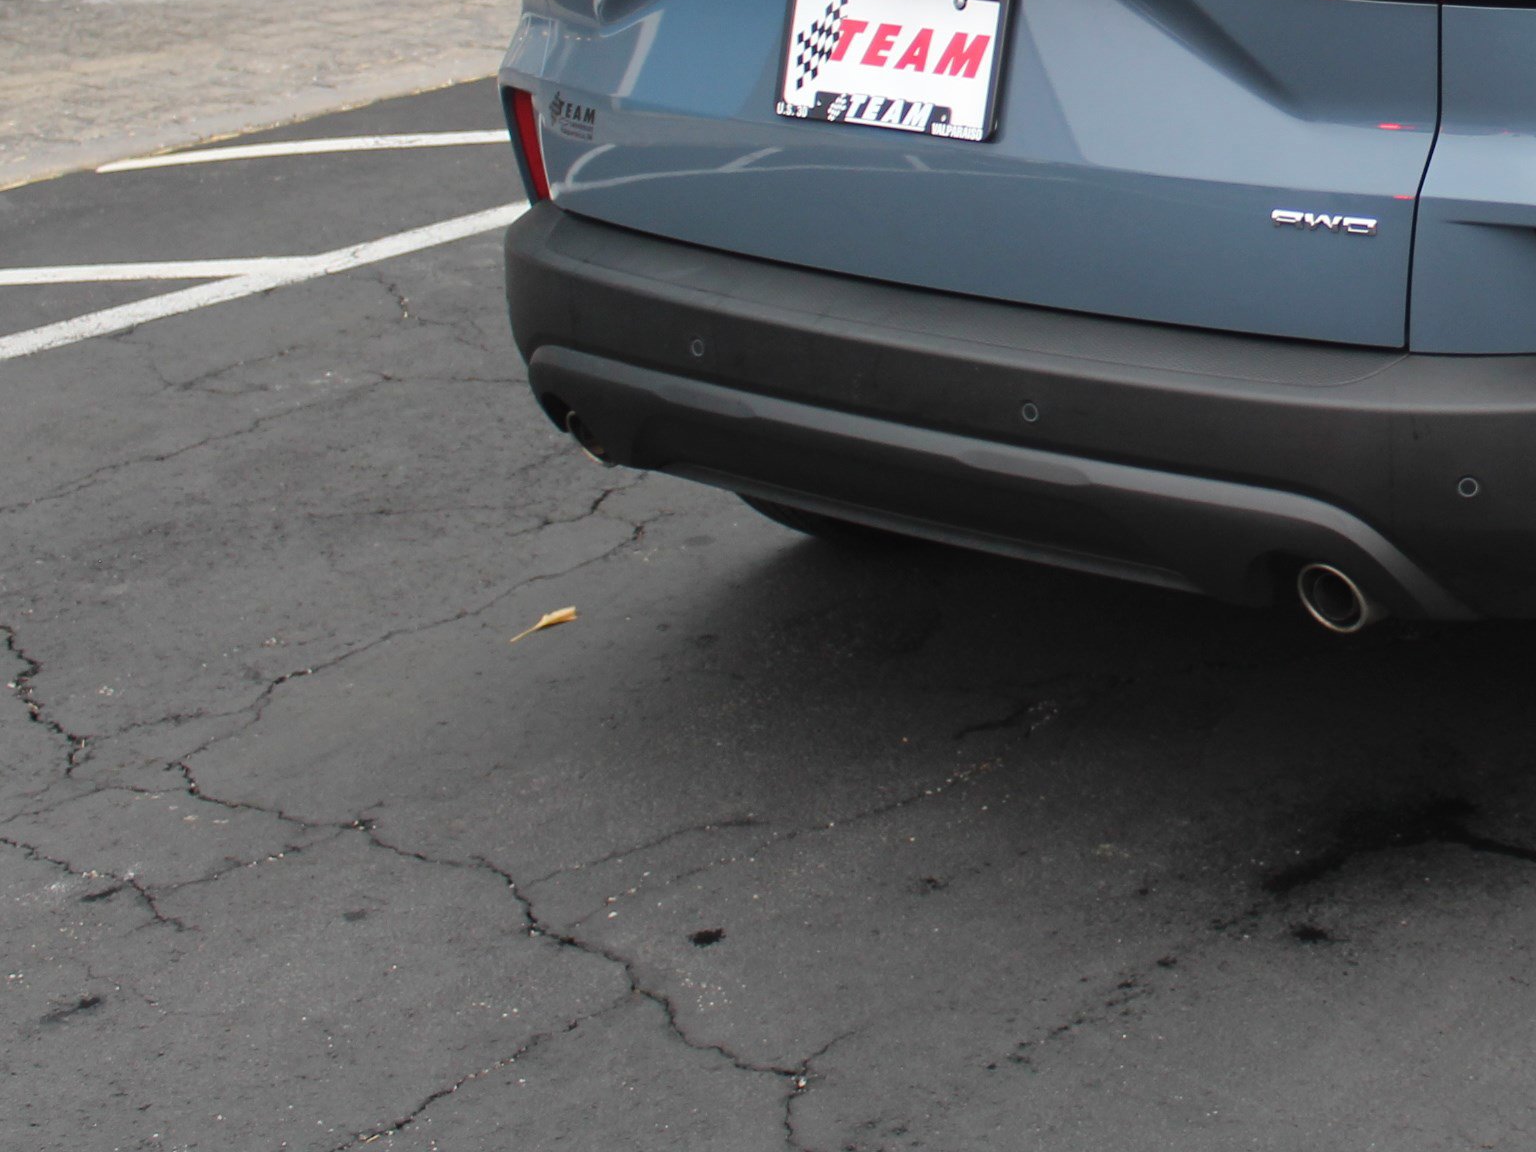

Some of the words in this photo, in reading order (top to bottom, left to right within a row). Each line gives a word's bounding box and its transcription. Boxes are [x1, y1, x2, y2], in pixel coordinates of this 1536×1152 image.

[831, 18, 990, 79] TEAM
[845, 94, 934, 128] TEAM
[931, 122, 983, 141] VALPARAISO
